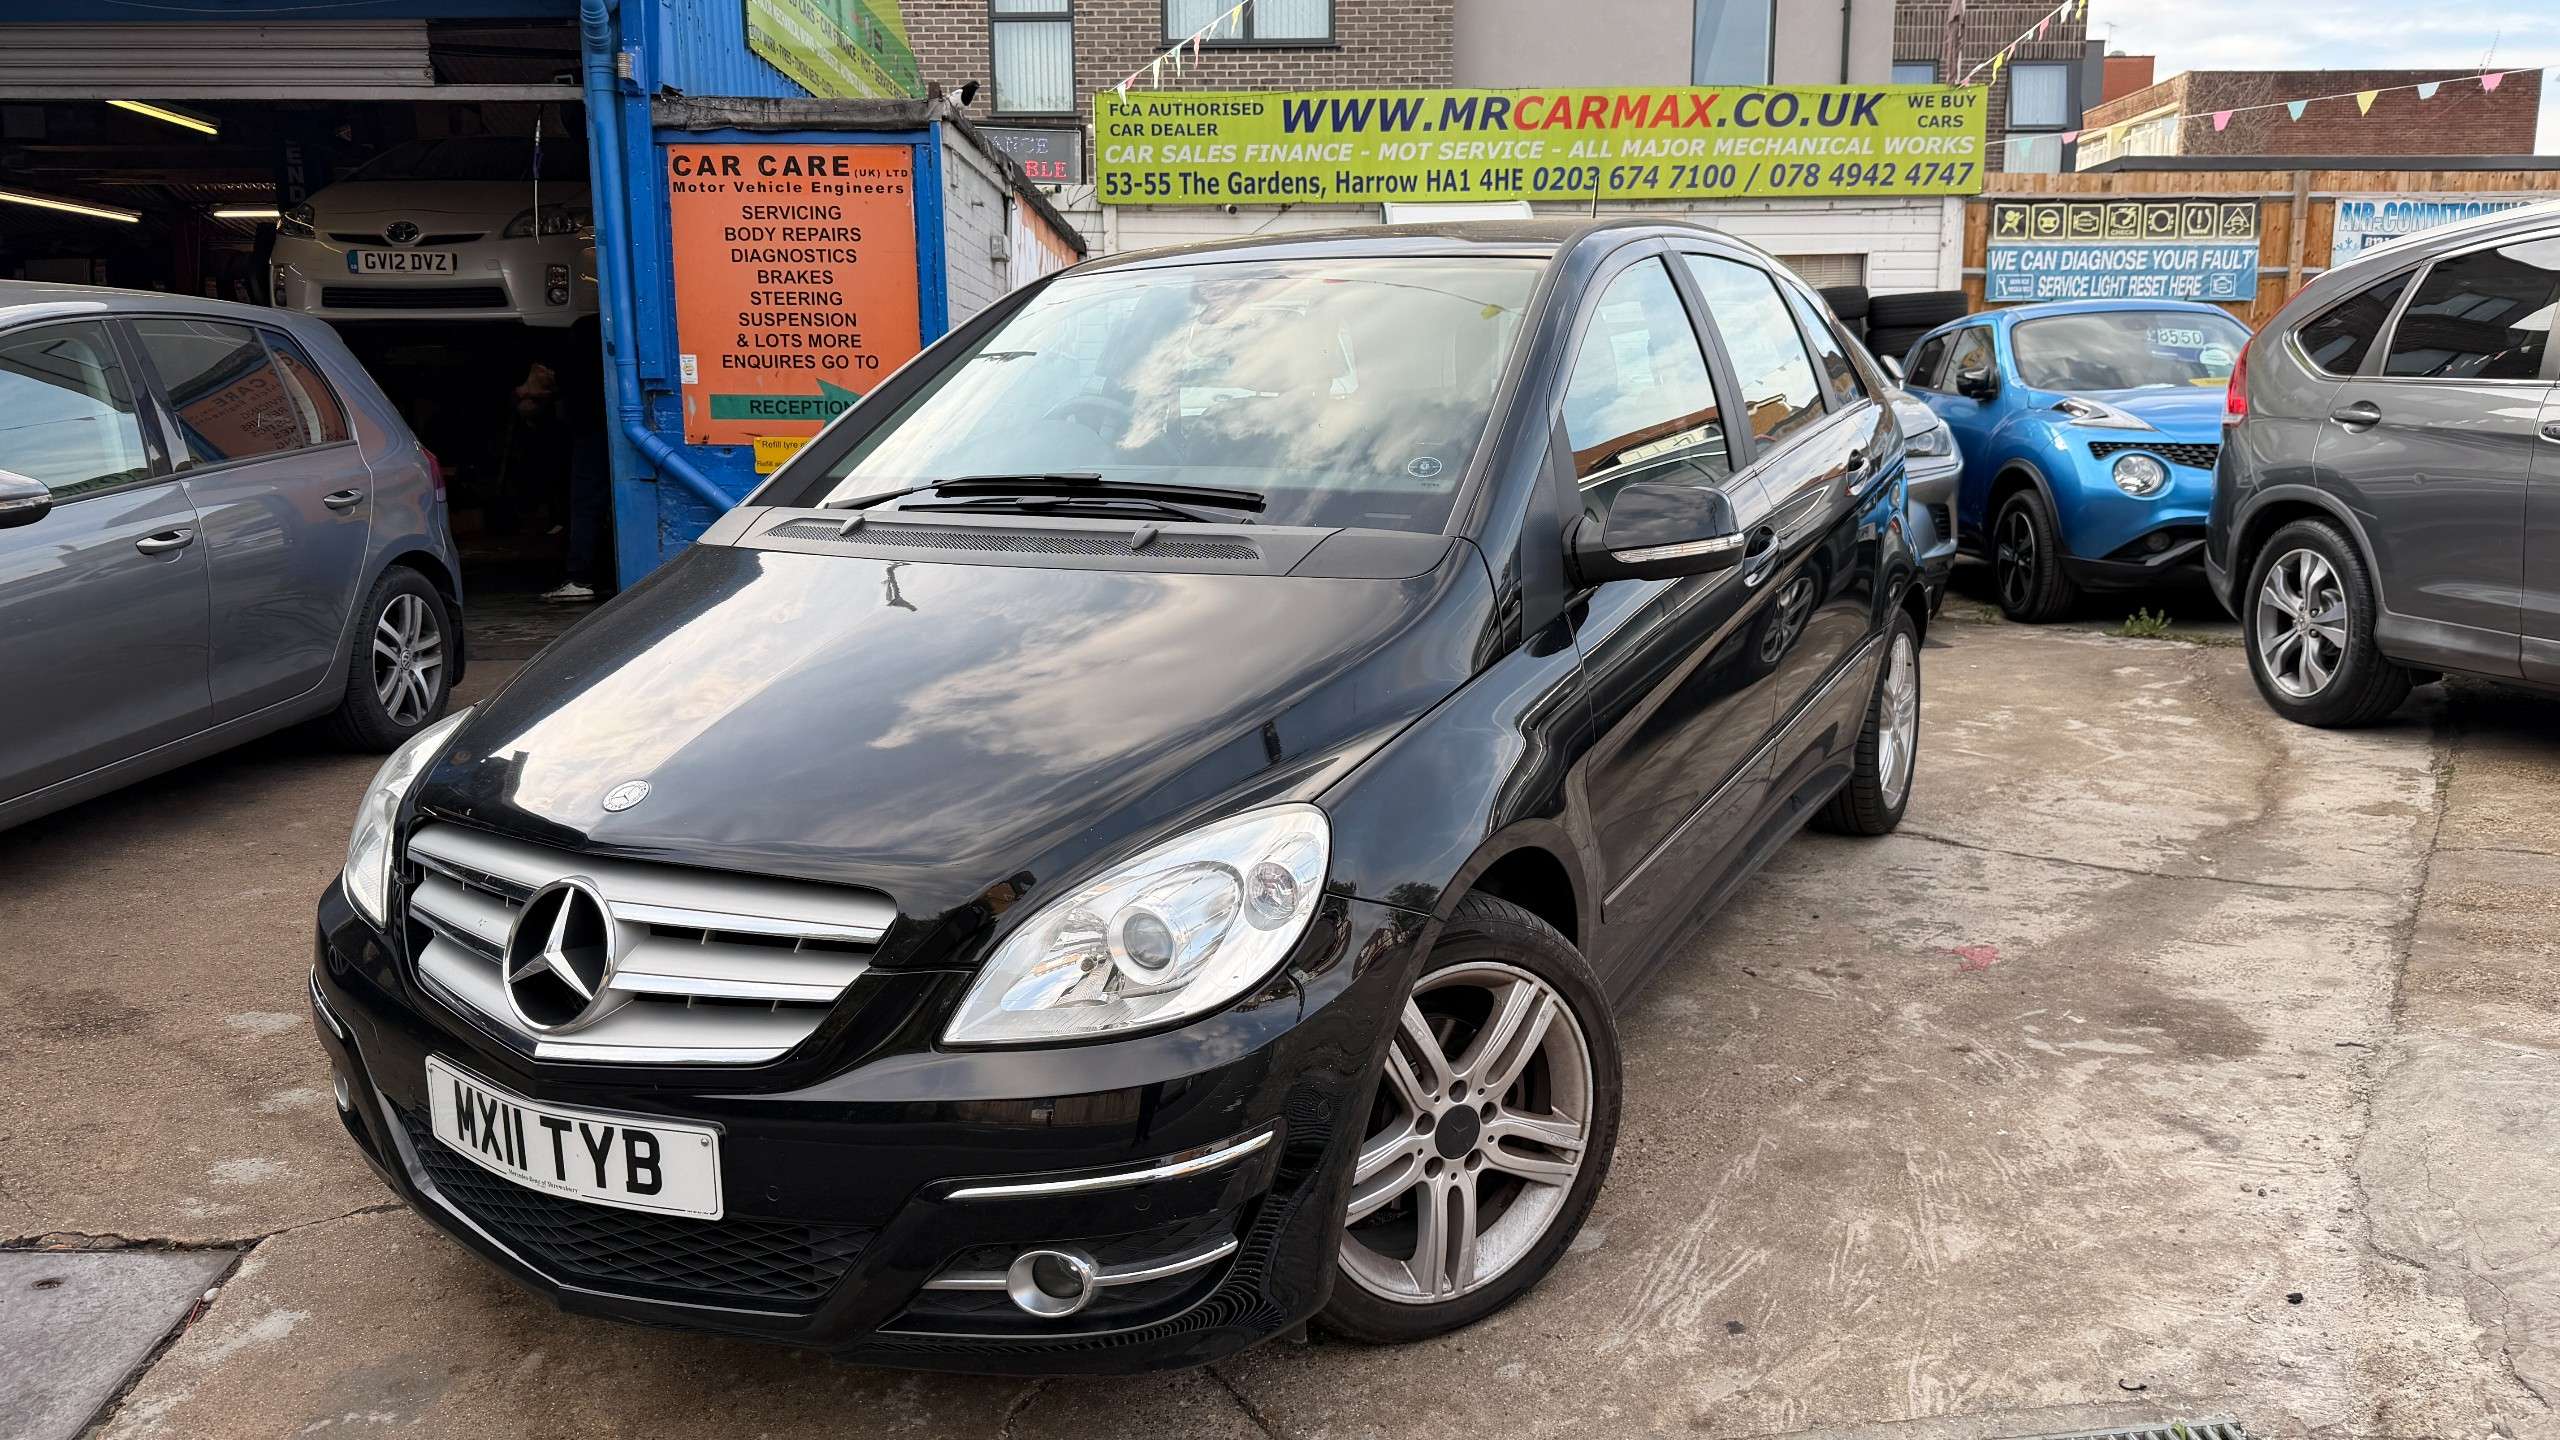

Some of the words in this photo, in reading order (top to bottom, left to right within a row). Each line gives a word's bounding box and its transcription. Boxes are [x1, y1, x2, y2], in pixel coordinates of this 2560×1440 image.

[1908, 94, 1937, 109] WE
[1941, 94, 1976, 108] BUY
[1109, 103, 1144, 117] FCA
[1148, 102, 1264, 117] AUTHORISED
[1282, 92, 1886, 134] WWW.MRCARMAX.CO.UK
[1917, 114, 1964, 129] CARS
[1110, 123, 1144, 137] CAR
[1150, 122, 1218, 136] DEALER
[1105, 145, 1157, 164] CAR
[1162, 144, 1237, 163] SALES
[1243, 143, 1354, 162] FINANCE
[1378, 141, 1432, 161] MOT
[1437, 140, 1545, 160] SERVICE
[1567, 139, 1613, 158] ALL
[1620, 138, 1706, 158] MAJOR
[1712, 136, 1874, 157] MECHANICAL
[1883, 135, 1975, 155] WORKS
[672, 155, 741, 177] CAR
[758, 155, 850, 177] CARE
[854, 169, 881, 179] (UK)
[886, 169, 908, 178] LTD
[1025, 160, 1068, 178] BLE
[1105, 171, 1172, 196] 53-55
[1178, 171, 1220, 195] The
[1226, 171, 1327, 199] Gardens,
[1335, 169, 1418, 195] Harrow
[1426, 169, 1470, 193] HA1
[1480, 167, 1523, 192] 4HE
[1532, 165, 1600, 192] 0203
[1609, 165, 1660, 190] 674
[1670, 164, 1736, 190] 7100
[1769, 162, 1820, 188] 078
[1829, 161, 1896, 187] 4942
[1904, 161, 1975, 186] 4747
[673, 181, 725, 193] Motor
[733, 181, 802, 193] Vehicle
[811, 182, 904, 196] Engineers
[742, 205, 842, 220] SERVICING
[724, 227, 776, 242] BODY
[782, 227, 862, 242] REPAIRS
[364, 253, 406, 270] GV12
[411, 253, 447, 271] DVZ
[731, 248, 857, 264] DIAGNOSTICS
[1991, 250, 2018, 271] WE
[2021, 250, 2058, 271] CAN
[2060, 249, 2148, 271] DIAGNOSE
[2152, 250, 2199, 270] YOUR
[2201, 250, 2255, 270] FAULT
[757, 270, 834, 285] BRAKES
[2037, 275, 2090, 298] SERVICE
[2090, 275, 2128, 298] LIGHT
[2129, 275, 2169, 297] RESET
[2170, 275, 2202, 296] HERE
[750, 291, 843, 306] STEERING
[738, 312, 857, 327] SUSPENSION
[736, 333, 749, 348] &
[755, 333, 802, 348] LOTS
[808, 333, 862, 348] MORE
[722, 354, 816, 369] ENQUIRES
[821, 354, 849, 369] GO
[855, 354, 879, 369] TO
[762, 440, 782, 448] Refill
[783, 441, 798, 450] tyre
[454, 1079, 528, 1171] MX11
[539, 1114, 663, 1196] TYB
